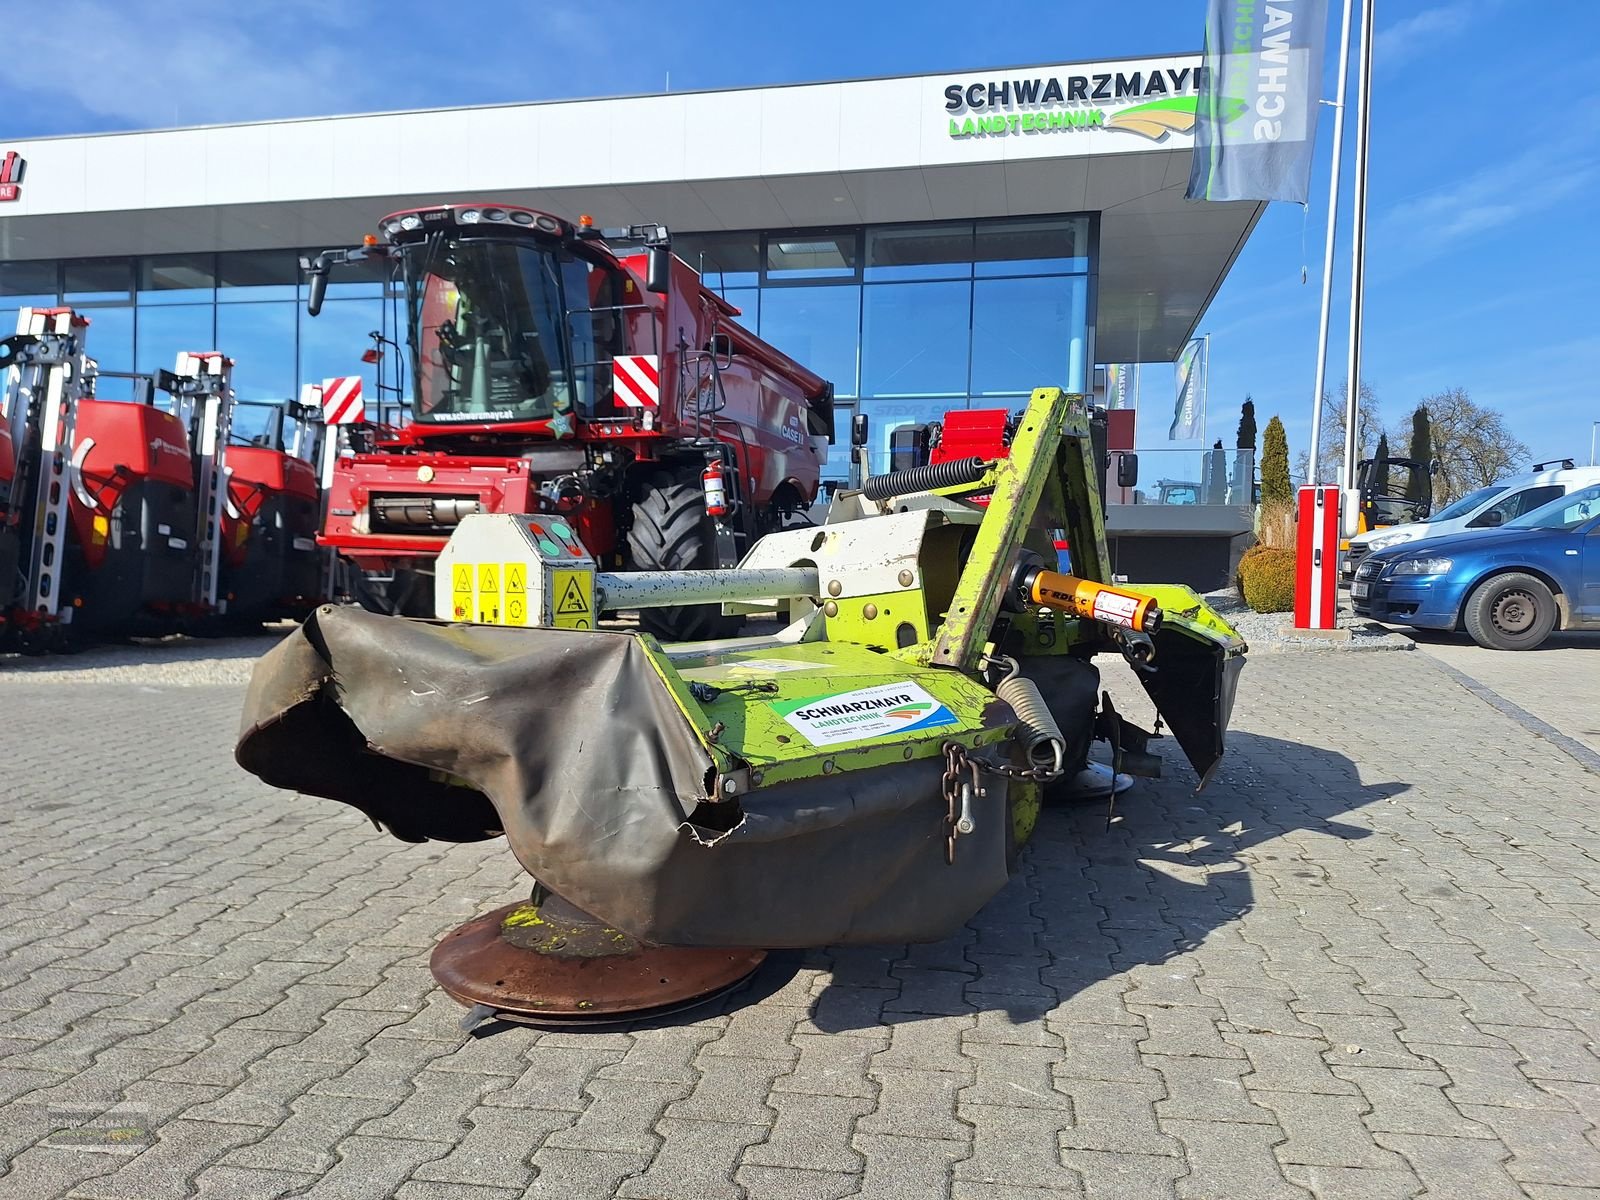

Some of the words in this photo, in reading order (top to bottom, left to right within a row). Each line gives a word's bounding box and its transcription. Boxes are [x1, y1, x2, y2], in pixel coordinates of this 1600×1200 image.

[949, 109, 1103, 136] LANDTECHNIK
[795, 694, 914, 721] SCHWARZMAYR
[811, 711, 883, 729] LANDTECHNIK
